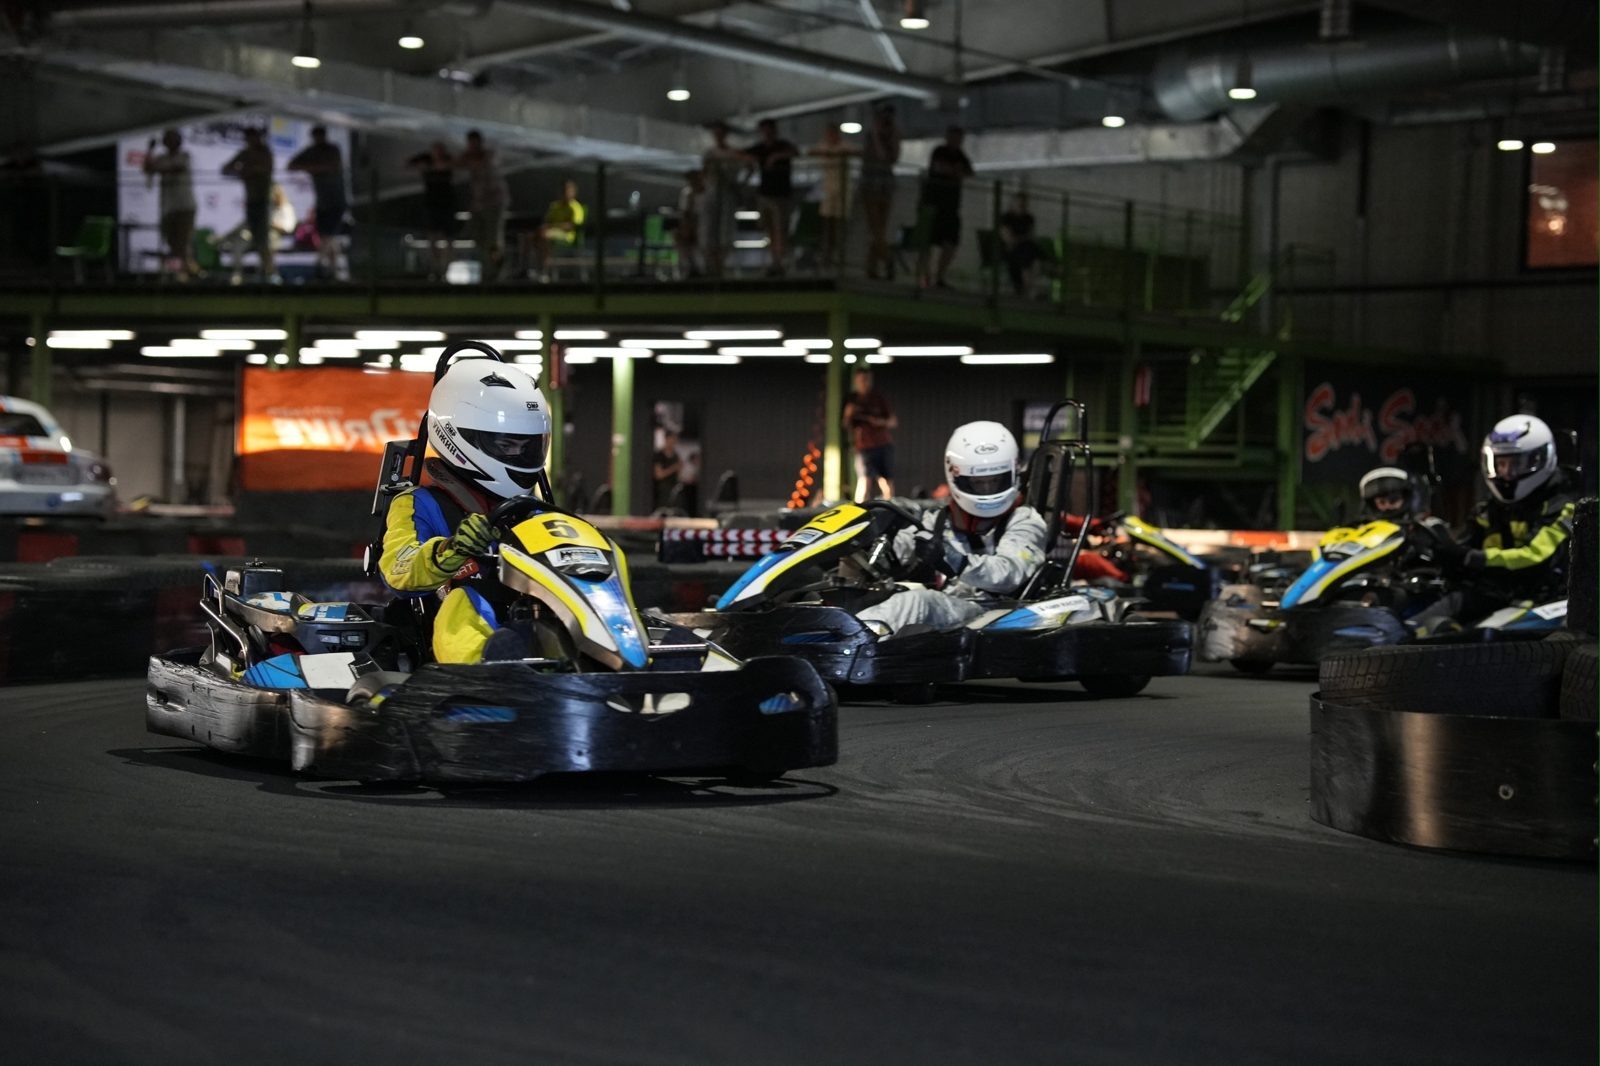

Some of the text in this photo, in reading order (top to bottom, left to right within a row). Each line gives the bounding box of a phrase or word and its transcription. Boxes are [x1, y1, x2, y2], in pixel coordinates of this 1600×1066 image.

[526, 402, 539, 410] OMP
[444, 422, 456, 436] OMP
[814, 509, 841, 523] 2
[542, 519, 579, 538] 5
